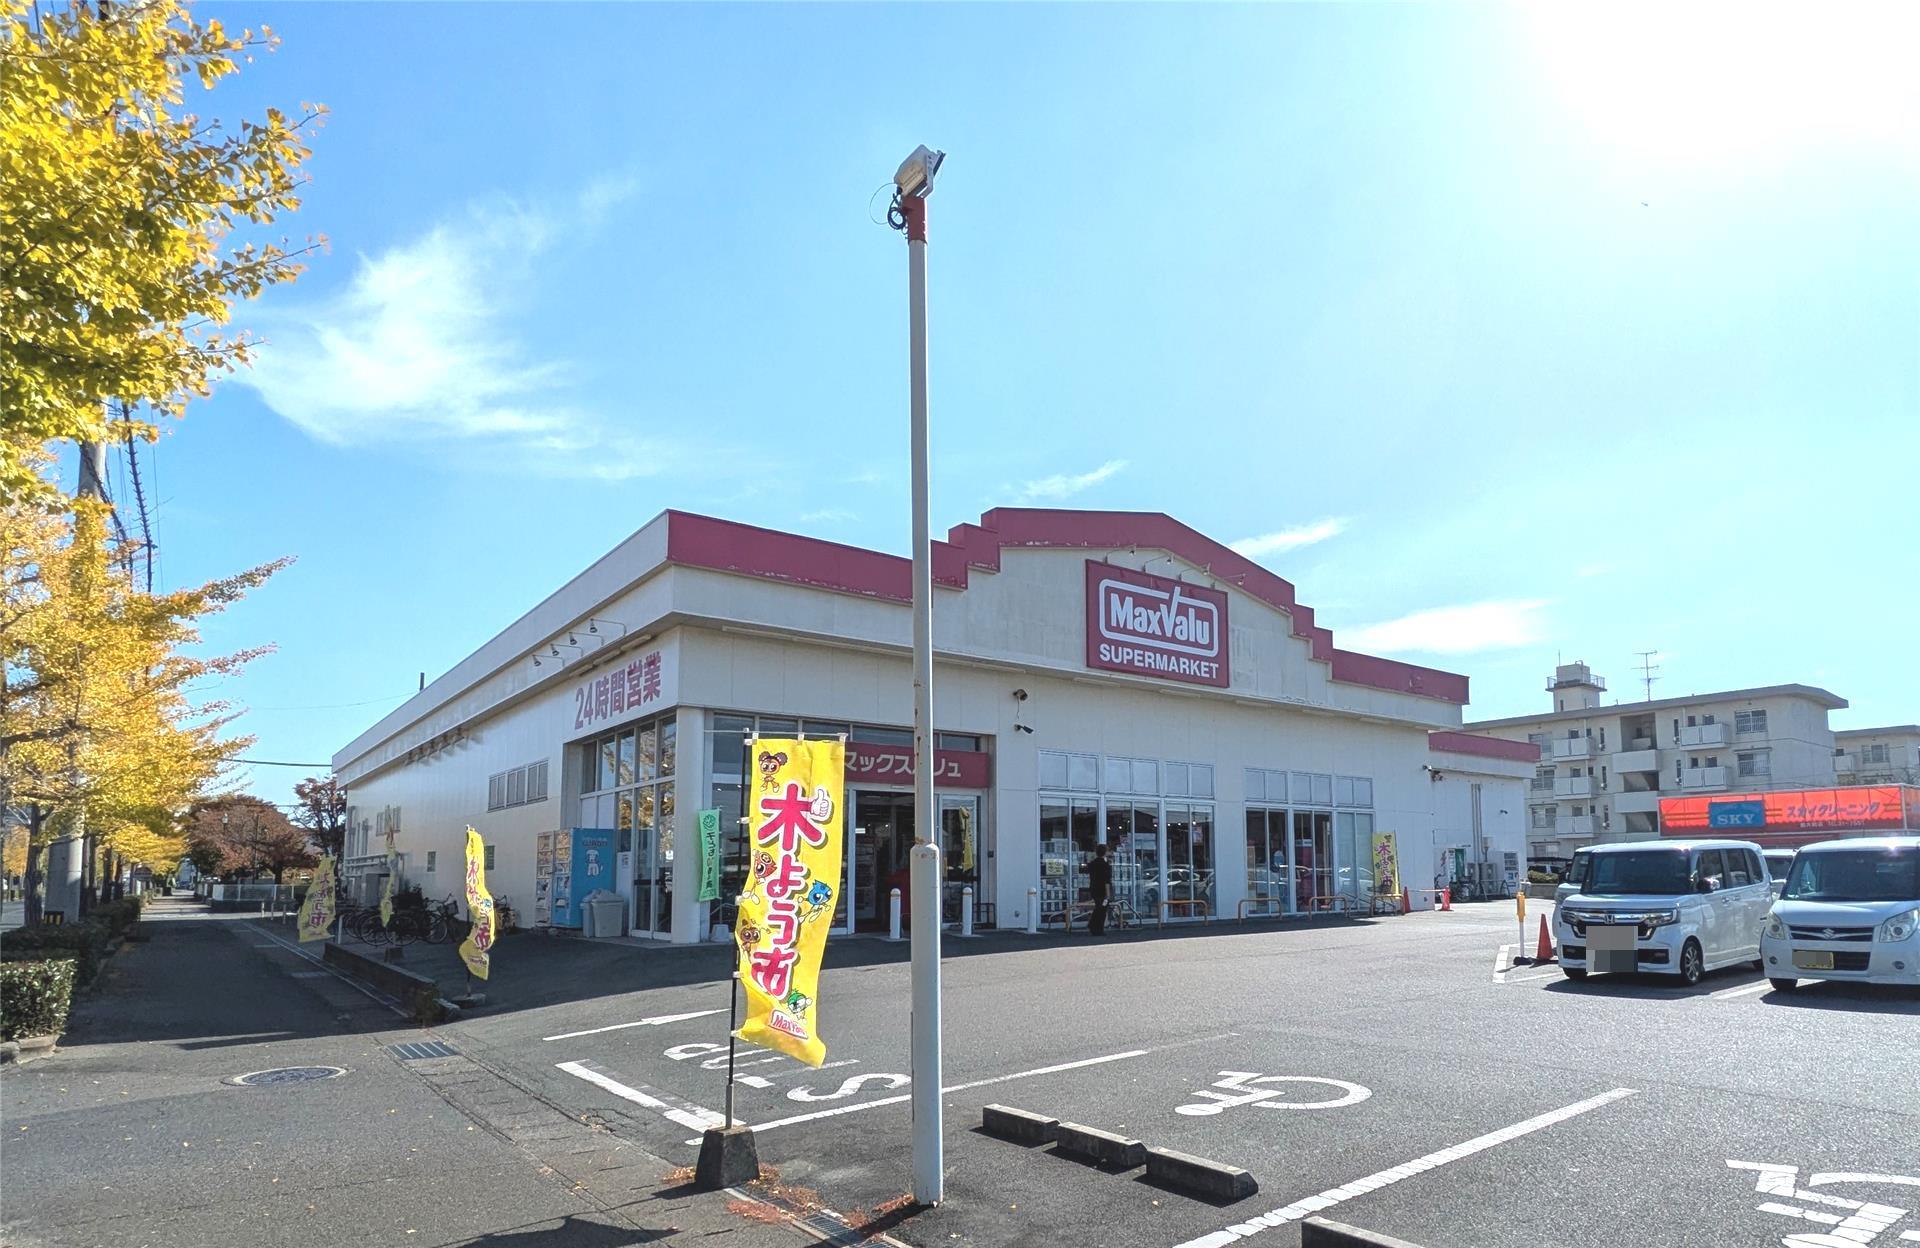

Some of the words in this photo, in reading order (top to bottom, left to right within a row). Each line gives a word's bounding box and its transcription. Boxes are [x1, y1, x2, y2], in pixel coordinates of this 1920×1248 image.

[1110, 586, 1209, 645] MaxValu
[574, 651, 662, 730] 24時間営業
[1100, 643, 1219, 679] SUPERMARKET
[1717, 813, 1756, 825] SKY
[752, 783, 830, 997] 木よう市
